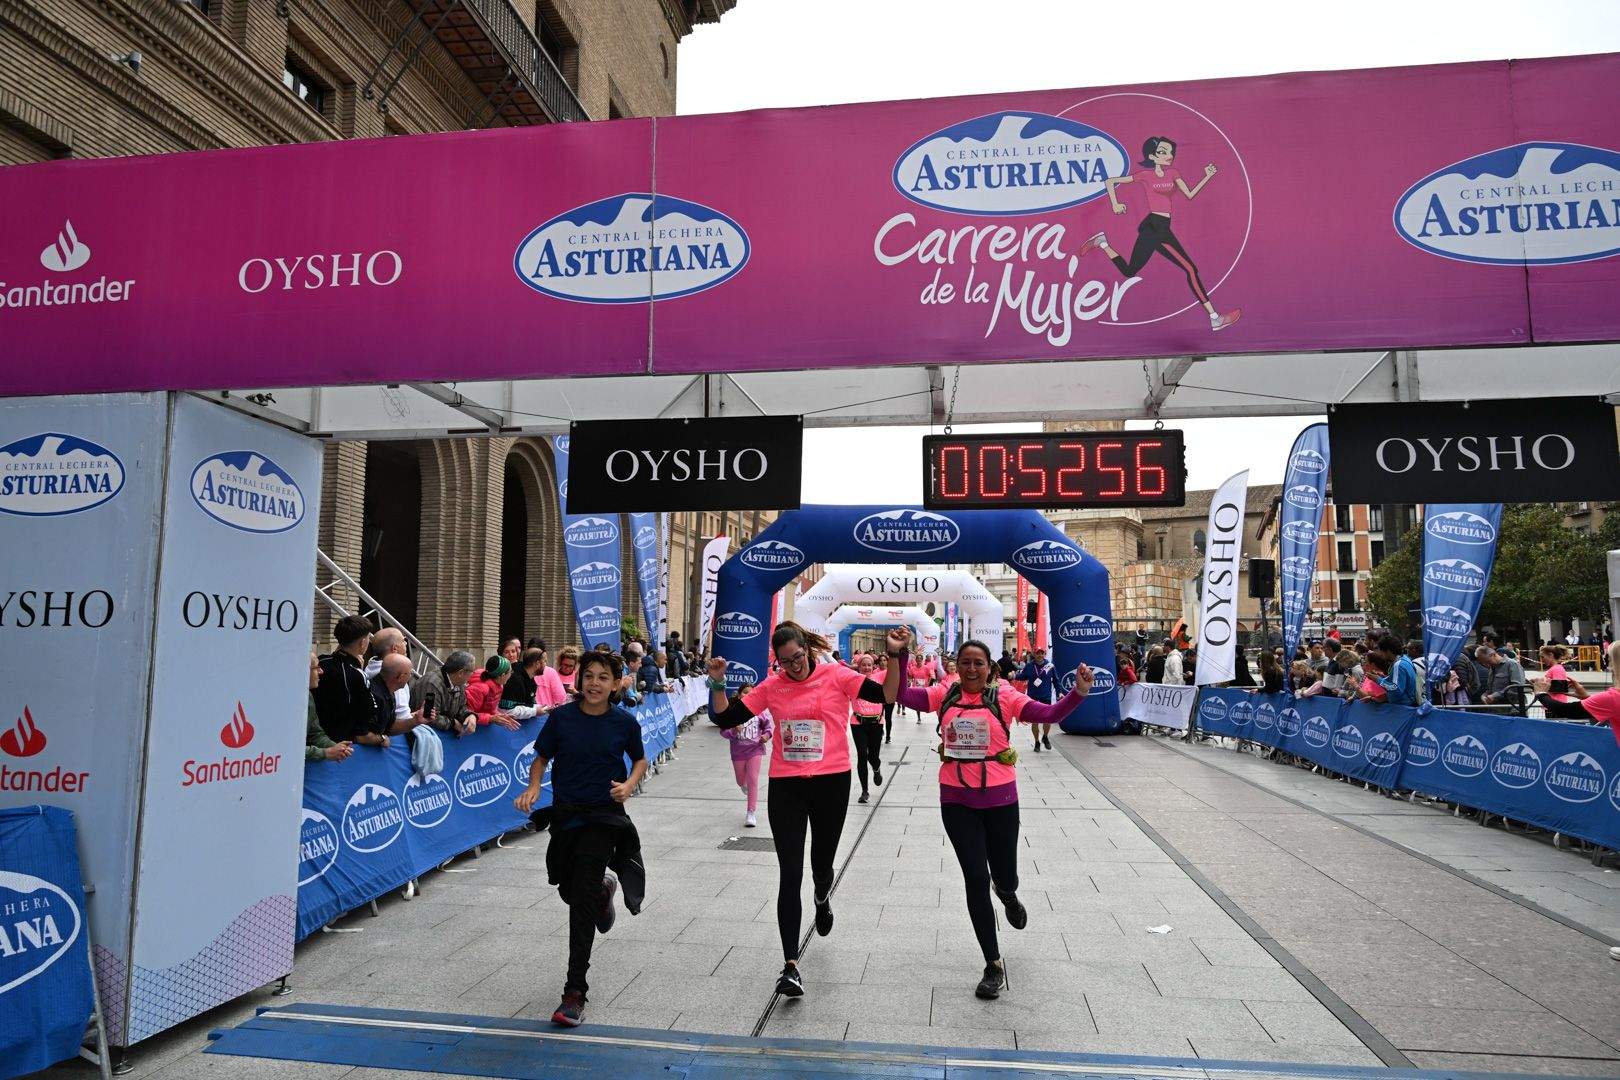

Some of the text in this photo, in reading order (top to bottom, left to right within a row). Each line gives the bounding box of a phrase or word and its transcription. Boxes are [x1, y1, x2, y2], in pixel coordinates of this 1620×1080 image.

[946, 143, 1102, 160] CENTRAL LECHERA
[910, 154, 1112, 192] ASTURIANA
[1459, 180, 1614, 200] CENTRAL LECH
[1417, 193, 1620, 238] ASTURIA
[568, 226, 724, 245] CENTRAL LECHERA
[874, 213, 1067, 266] Carrera
[238, 250, 403, 293] OYSHO
[531, 238, 731, 279] ASTURIANA
[920, 255, 1143, 347] de la Mujer
[5, 461, 109, 471] CENTRAL LECHERA
[605, 448, 768, 483] OYSHO
[1375, 433, 1577, 474] OYSHO
[0, 472, 112, 496] STURIANA
[199, 469, 297, 520] ASTURIANA
[861, 522, 952, 542] ASTURIANA
[744, 553, 800, 564] ASTURIANA
[1018, 552, 1078, 564] ASTURIANA
[857, 577, 939, 593] OYSHO
[1204, 503, 1240, 647] OYSHO
[0, 590, 114, 628] YSHO
[182, 591, 298, 632] OYSHO
[1063, 625, 1110, 637] ASTURIANA
[1142, 687, 1182, 708] OYSHO
[0, 766, 89, 793] tander
[182, 752, 281, 787] Santander
[1494, 756, 1537, 780] ASTURIANA
[1547, 766, 1600, 794] ASTURIANA
[459, 773, 508, 799] ASTURIANA
[407, 791, 450, 818] ASTURIANA
[349, 807, 402, 843] ASTURIANA
